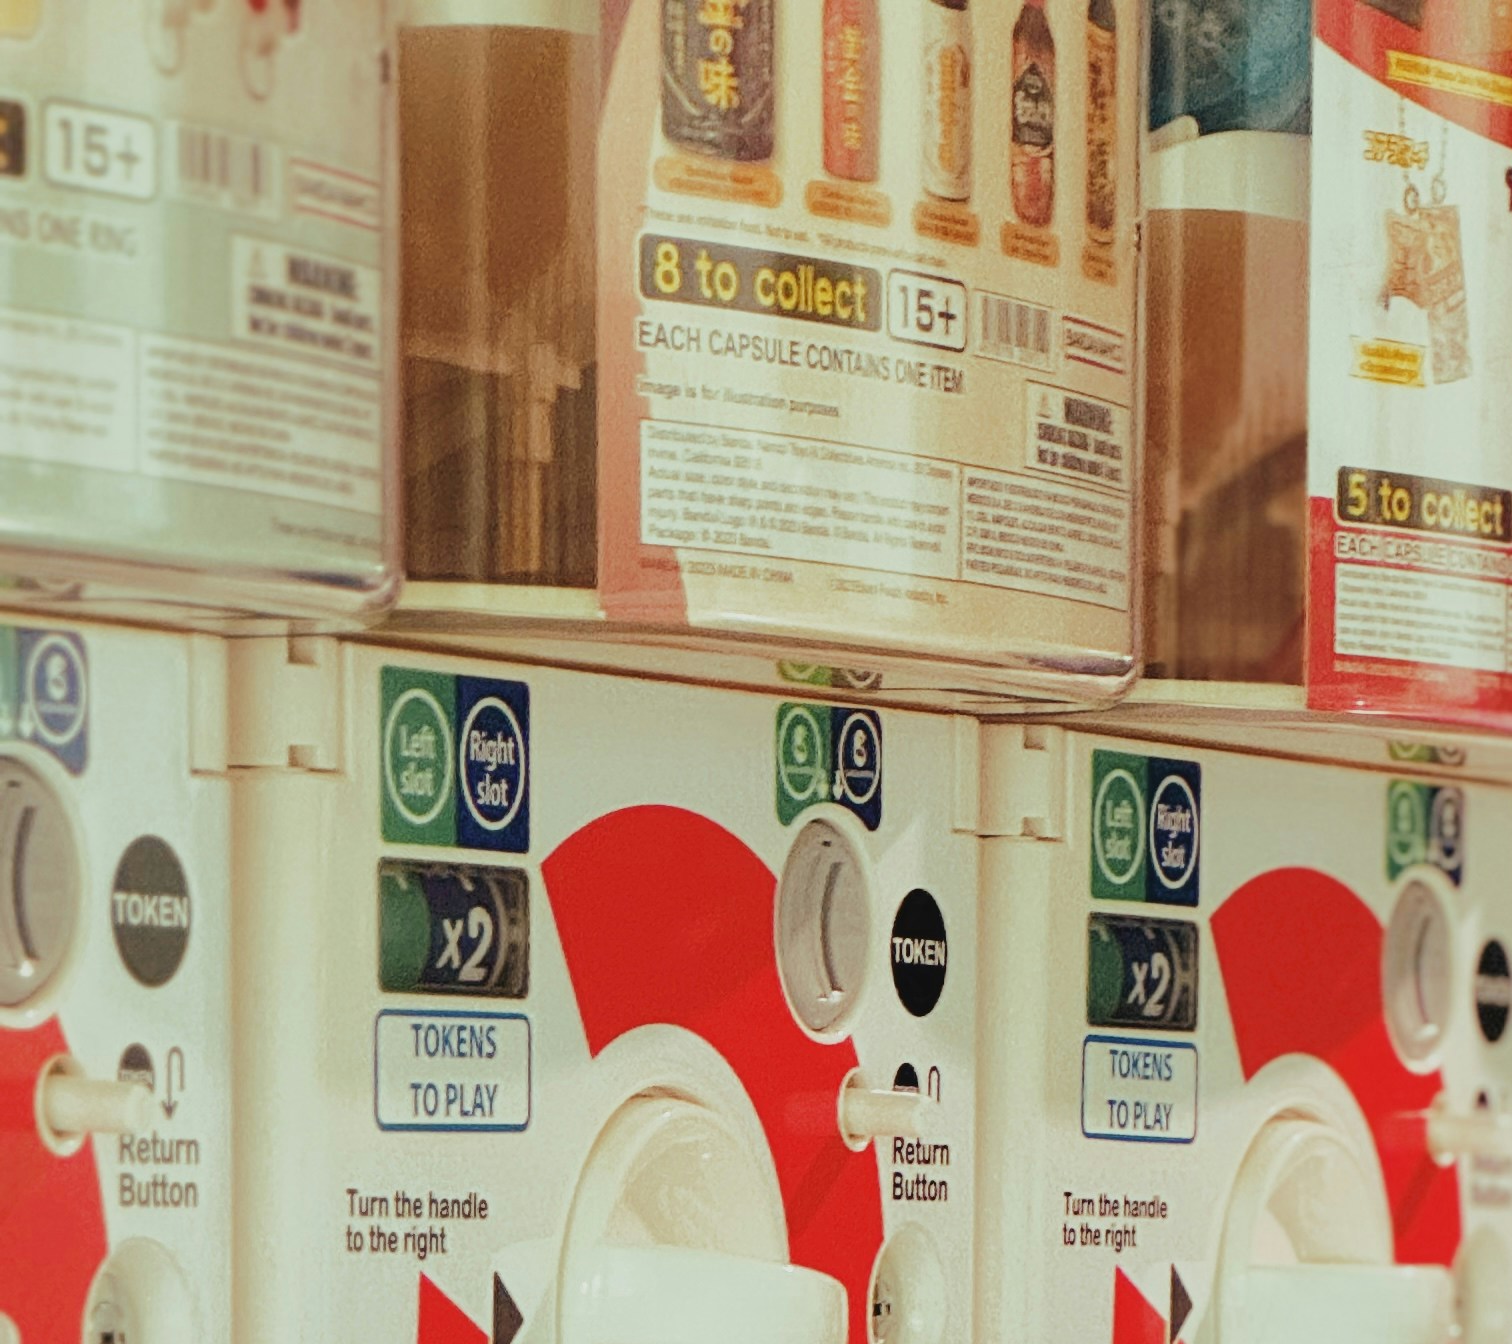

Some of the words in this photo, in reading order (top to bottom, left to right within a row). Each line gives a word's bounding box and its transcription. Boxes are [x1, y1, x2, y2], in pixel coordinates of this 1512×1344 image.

[58, 118, 141, 182] 15+
[655, 241, 681, 293] 8
[694, 248, 738, 301] to
[754, 264, 866, 322] collect
[898, 284, 956, 335] 15+
[638, 321, 701, 352] EACH
[708, 329, 800, 366] CAPSULE
[806, 343, 890, 381] CONTAINS
[895, 358, 926, 388] ONE
[930, 364, 965, 393] ITEM
[1347, 473, 1368, 515] 5
[1378, 479, 1411, 521] to
[1422, 488, 1504, 536] collect
[400, 723, 437, 759] Left
[469, 730, 516, 771] Right
[401, 761, 433, 797] slot
[477, 773, 509, 807] slot
[113, 892, 190, 928] TOKEN
[435, 905, 493, 983] x2
[892, 936, 946, 967] TOKEN
[1127, 952, 1170, 1017] x2
[411, 1023, 497, 1059] TOKENS
[1109, 1049, 1173, 1082] TOKENS
[410, 1082, 439, 1117] TO
[444, 1083, 499, 1118] PLAY
[1107, 1099, 1129, 1130] TO
[1132, 1100, 1174, 1132] PLAY
[118, 1130, 200, 1165] Return
[893, 1136, 950, 1165] Return
[118, 1172, 199, 1208] Button
[346, 1188, 389, 1217] Turn
[394, 1190, 423, 1218] the
[428, 1190, 488, 1219] handle
[892, 1172, 948, 1202] Button
[1063, 1191, 1095, 1217] Turn
[1098, 1193, 1119, 1218] the
[1123, 1194, 1168, 1220] handle
[346, 1225, 364, 1252] to
[369, 1225, 398, 1253] the
[404, 1225, 447, 1260] right
[1063, 1224, 1077, 1247] to
[1080, 1225, 1101, 1247] the
[1105, 1226, 1137, 1253] right
